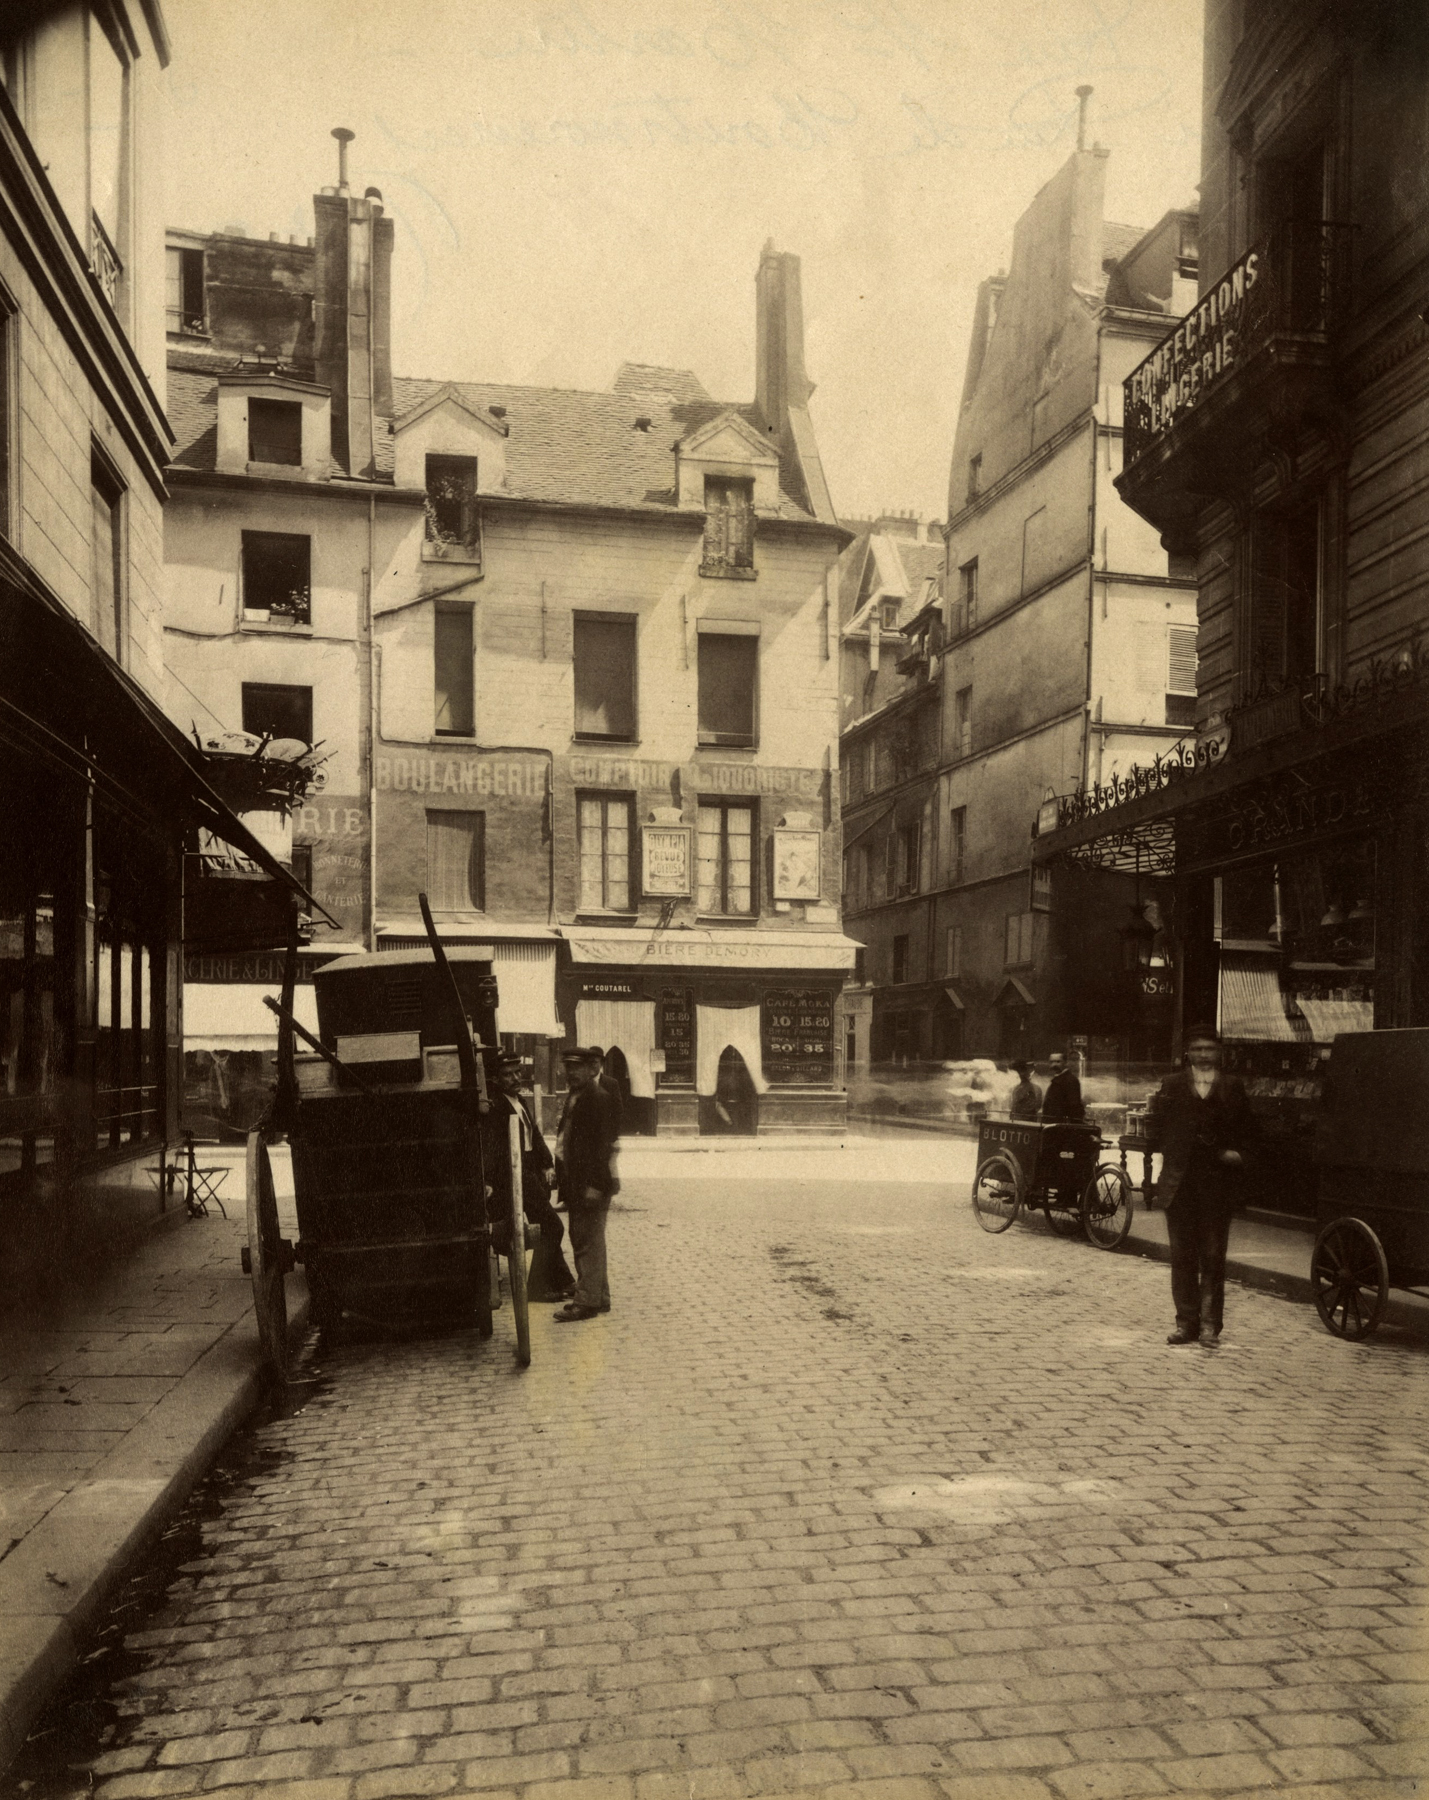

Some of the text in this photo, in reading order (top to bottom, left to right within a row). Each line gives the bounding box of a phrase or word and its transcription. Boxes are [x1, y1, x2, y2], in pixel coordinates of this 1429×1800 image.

[1132, 254, 1259, 405] CONFECTIONS
[1151, 330, 1234, 433] LINGERIE
[376, 756, 548, 797] BOULANGERIE
[297, 806, 364, 837] RIE
[595, 984, 632, 993] COUTAREL
[983, 1128, 1031, 1145] BLOTTO
